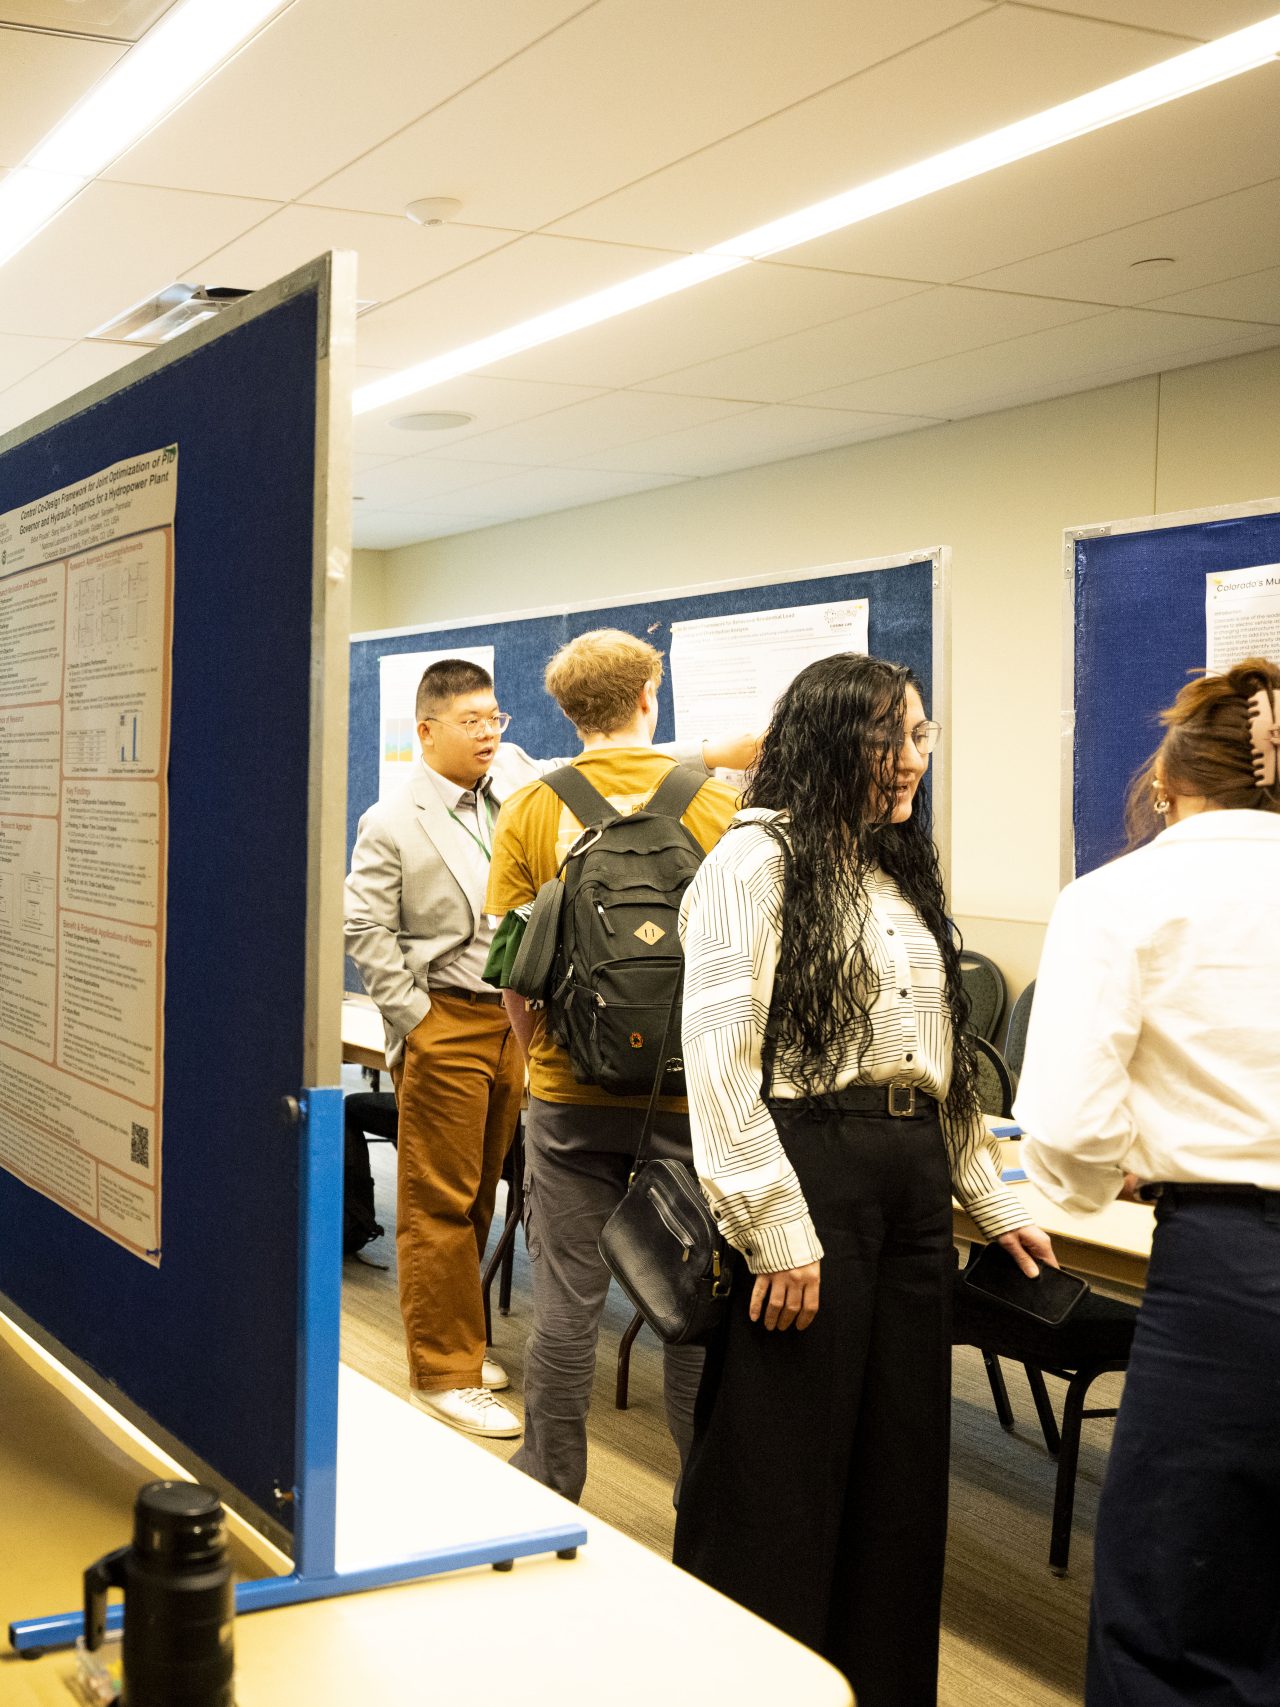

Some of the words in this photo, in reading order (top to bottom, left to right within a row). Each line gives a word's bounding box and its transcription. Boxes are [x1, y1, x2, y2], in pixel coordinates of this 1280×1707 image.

[19, 522, 40, 536] Governor
[40, 518, 50, 528] and
[50, 508, 71, 528] Hydraulic
[72, 498, 95, 516] Dynamics
[96, 494, 104, 504] for
[108, 478, 148, 502] Hydropower
[149, 470, 169, 488] Plant
[20, 507, 36, 520] Control
[37, 497, 60, 514] Co-Design
[61, 486, 87, 504] Framework
[95, 478, 108, 489] Joint
[109, 461, 150, 485] Optimization
[151, 456, 160, 469] of
[1216, 580, 1263, 592] Colorado's
